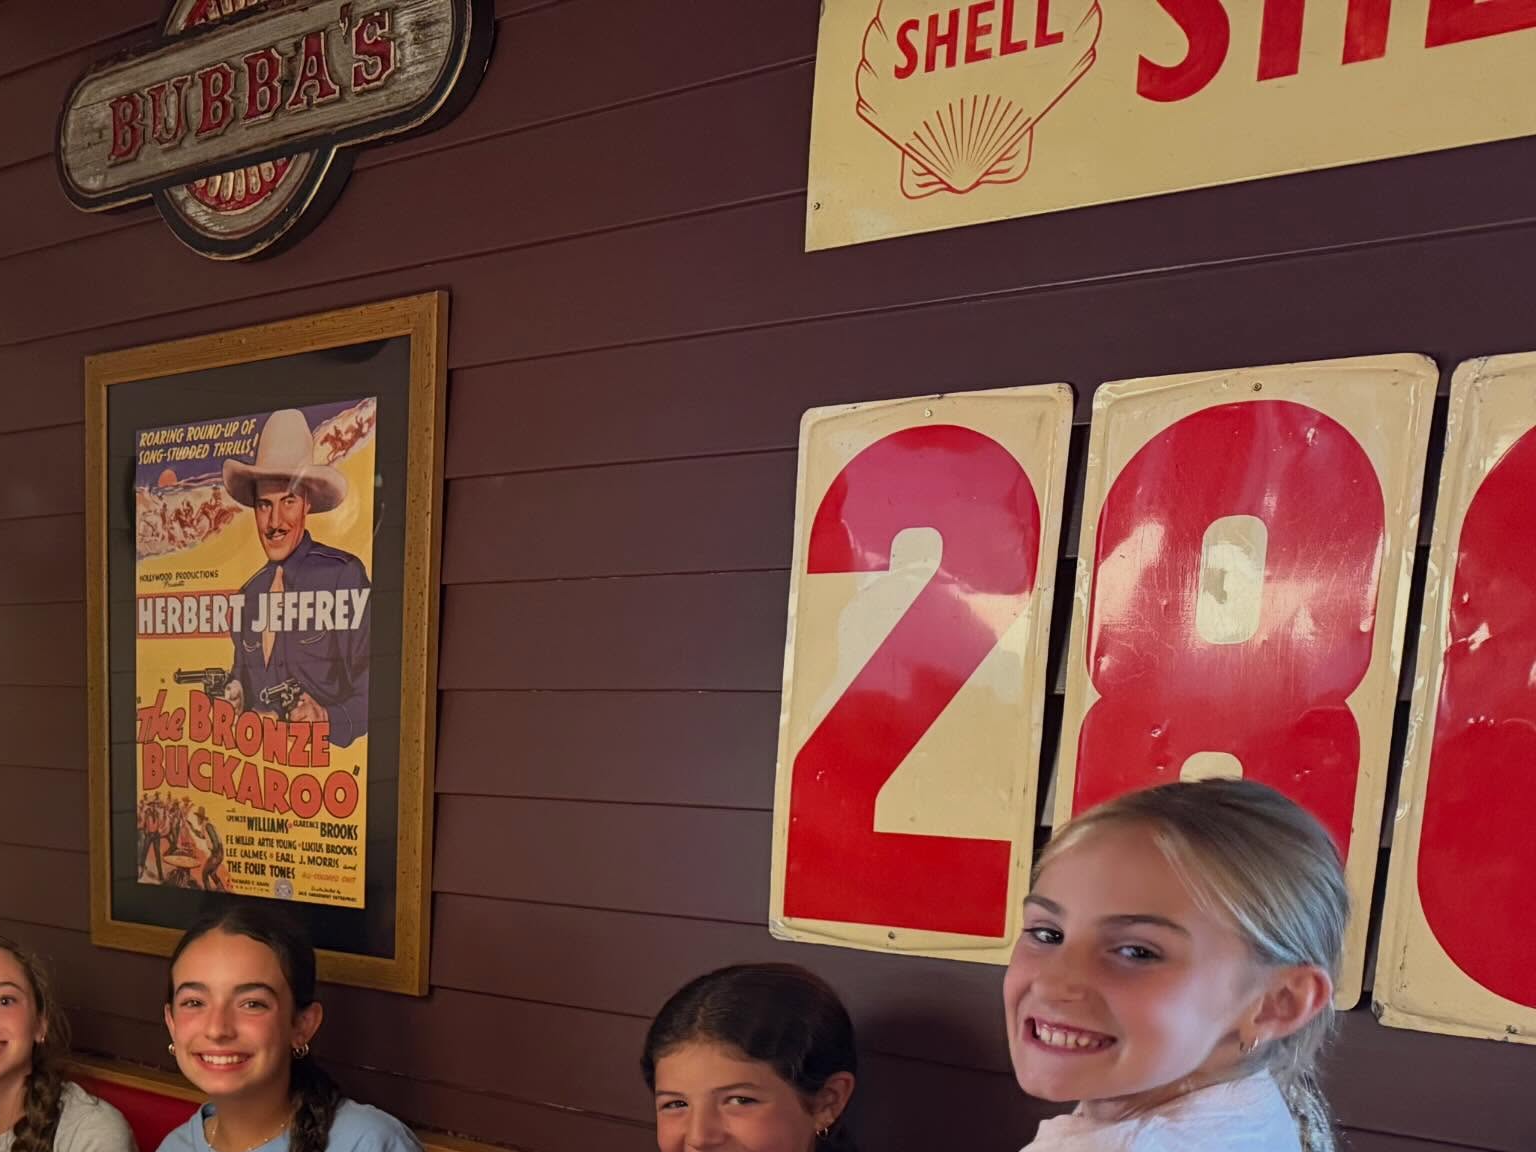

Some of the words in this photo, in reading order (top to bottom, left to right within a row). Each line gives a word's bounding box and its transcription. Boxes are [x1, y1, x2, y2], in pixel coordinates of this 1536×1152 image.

[894, 0, 1064, 80] SHELL
[106, 6, 397, 166] BUBBA'S
[139, 428, 184, 448] ROARING
[186, 421, 240, 442] ROUND-UP
[240, 418, 257, 435] OF
[138, 444, 210, 465] SONG-STUDDED
[212, 433, 259, 457] THRILLS!
[175, 569, 219, 580] PRODUCTIONS
[138, 594, 245, 634] HERBERT
[251, 588, 371, 633] JEFFREY
[189, 690, 330, 768] BRONZE
[247, 816, 289, 834] WILLIAMS
[320, 822, 358, 841] BROOKS
[226, 848, 238, 858] LEE
[275, 852, 296, 863] EARL
[298, 855, 307, 865] J.
[307, 856, 340, 868] MORRIS
[275, 839, 297, 851] YOUNG
[325, 844, 358, 857] BROOKS
[226, 861, 242, 874] THE
[244, 862, 266, 876] FOUR
[269, 864, 296, 880] TONES
